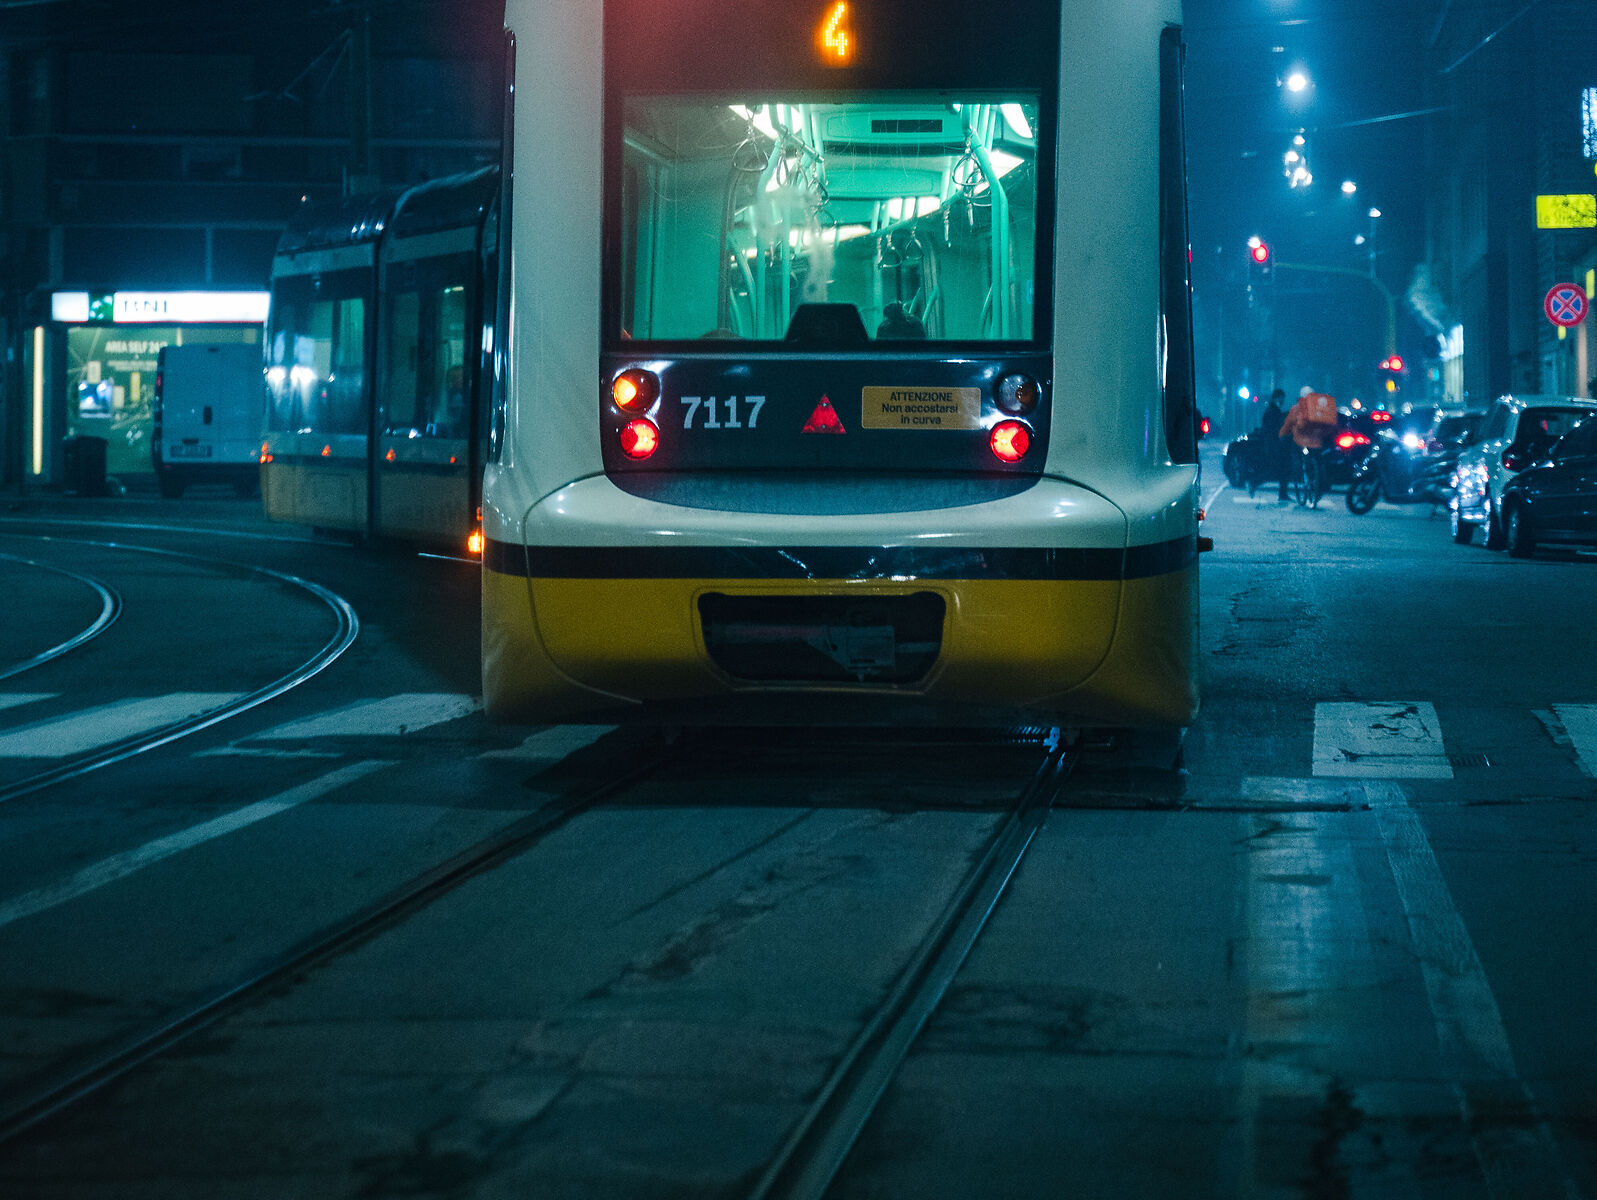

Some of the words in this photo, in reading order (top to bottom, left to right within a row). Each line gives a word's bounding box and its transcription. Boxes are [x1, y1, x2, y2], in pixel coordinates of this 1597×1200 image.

[824, 0, 849, 57] 4
[890, 391, 953, 402] ATTENZIONE
[680, 395, 766, 429] 7117
[882, 403, 903, 413] Non
[904, 404, 958, 413] accostarsi
[901, 415, 910, 424] in
[912, 416, 941, 424] curva
